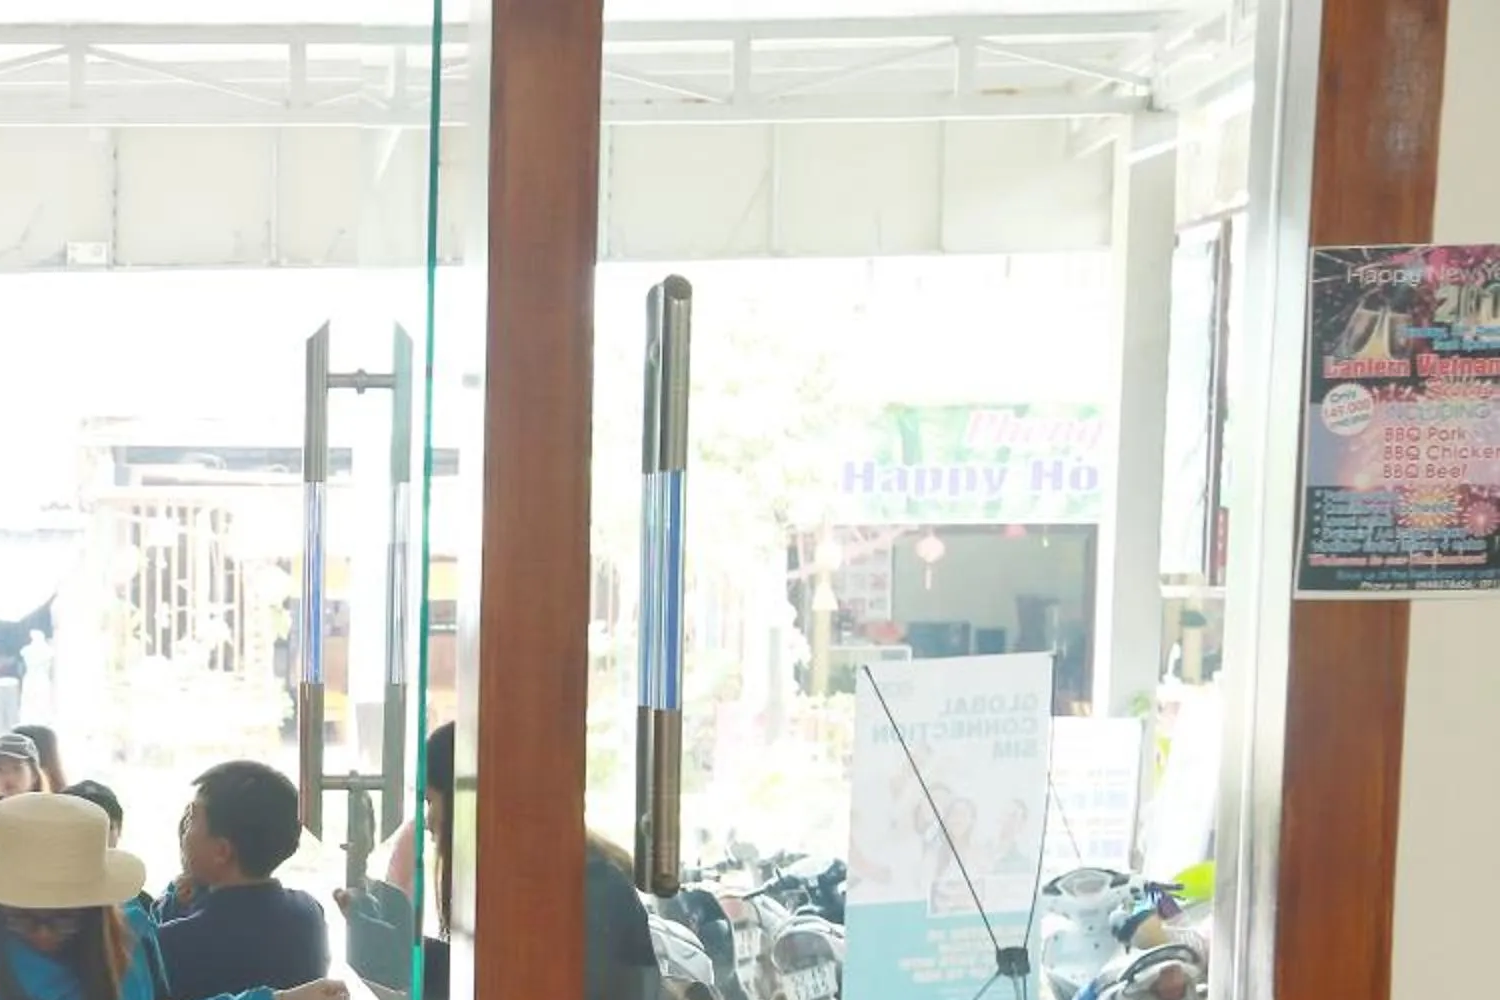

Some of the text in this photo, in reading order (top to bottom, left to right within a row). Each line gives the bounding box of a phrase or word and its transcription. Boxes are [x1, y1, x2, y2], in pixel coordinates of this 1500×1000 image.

[1347, 265, 1422, 287] Happy
[1384, 427, 1421, 443] BBQ
[1383, 446, 1421, 461] BBQ
[843, 461, 1008, 496] Happy
[1383, 464, 1468, 479] BBQ Beef
